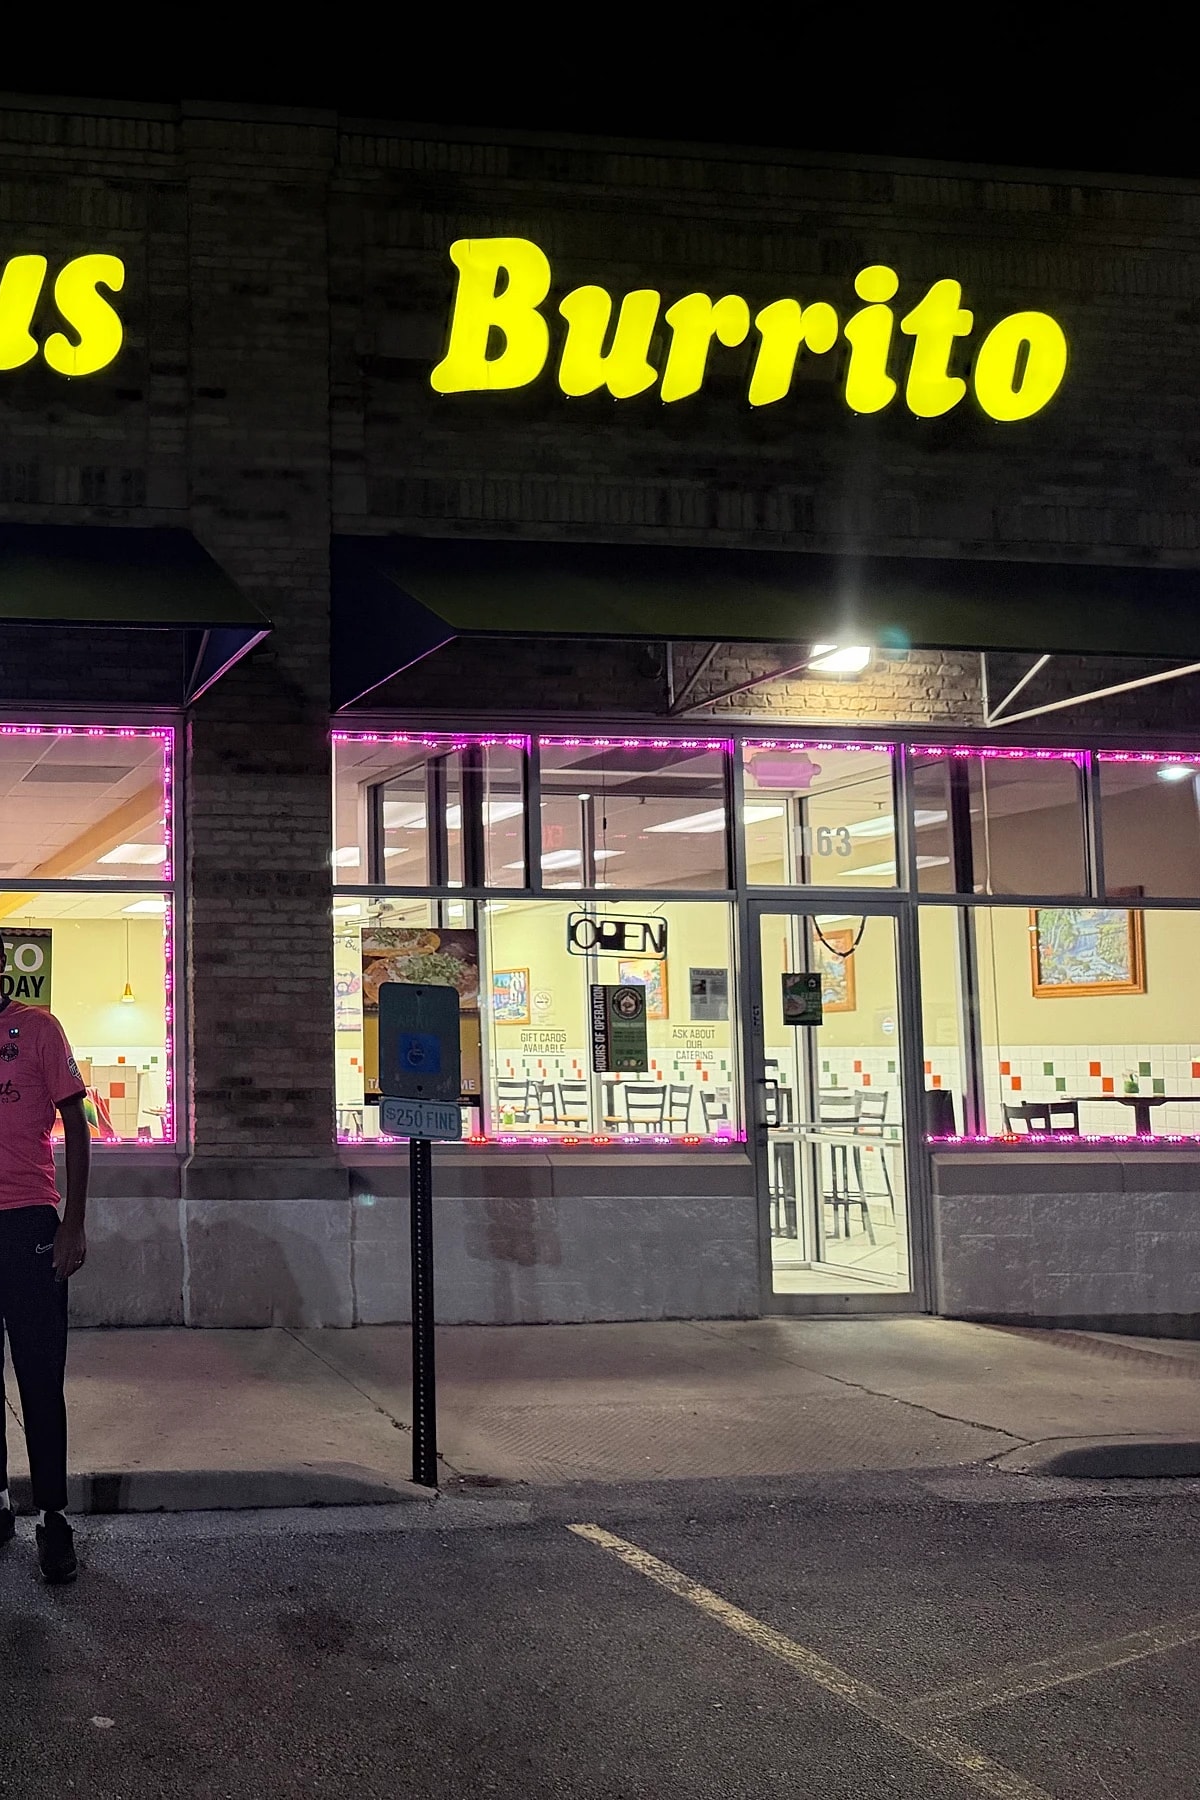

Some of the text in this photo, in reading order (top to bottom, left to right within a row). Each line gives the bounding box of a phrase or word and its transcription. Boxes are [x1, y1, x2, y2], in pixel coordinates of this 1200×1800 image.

[430, 237, 1068, 422] Burrito
[573, 918, 664, 953] OPEN
[593, 985, 607, 1072] HOURS OF OPERATION
[672, 1029, 715, 1039] ASK ABOUT
[520, 1032, 567, 1043] GIFT CARDS
[523, 1043, 565, 1053] AVAILABLE
[686, 1040, 703, 1049] OUR
[675, 1050, 714, 1060] CATERING
[386, 1106, 456, 1131] $250 FINE
